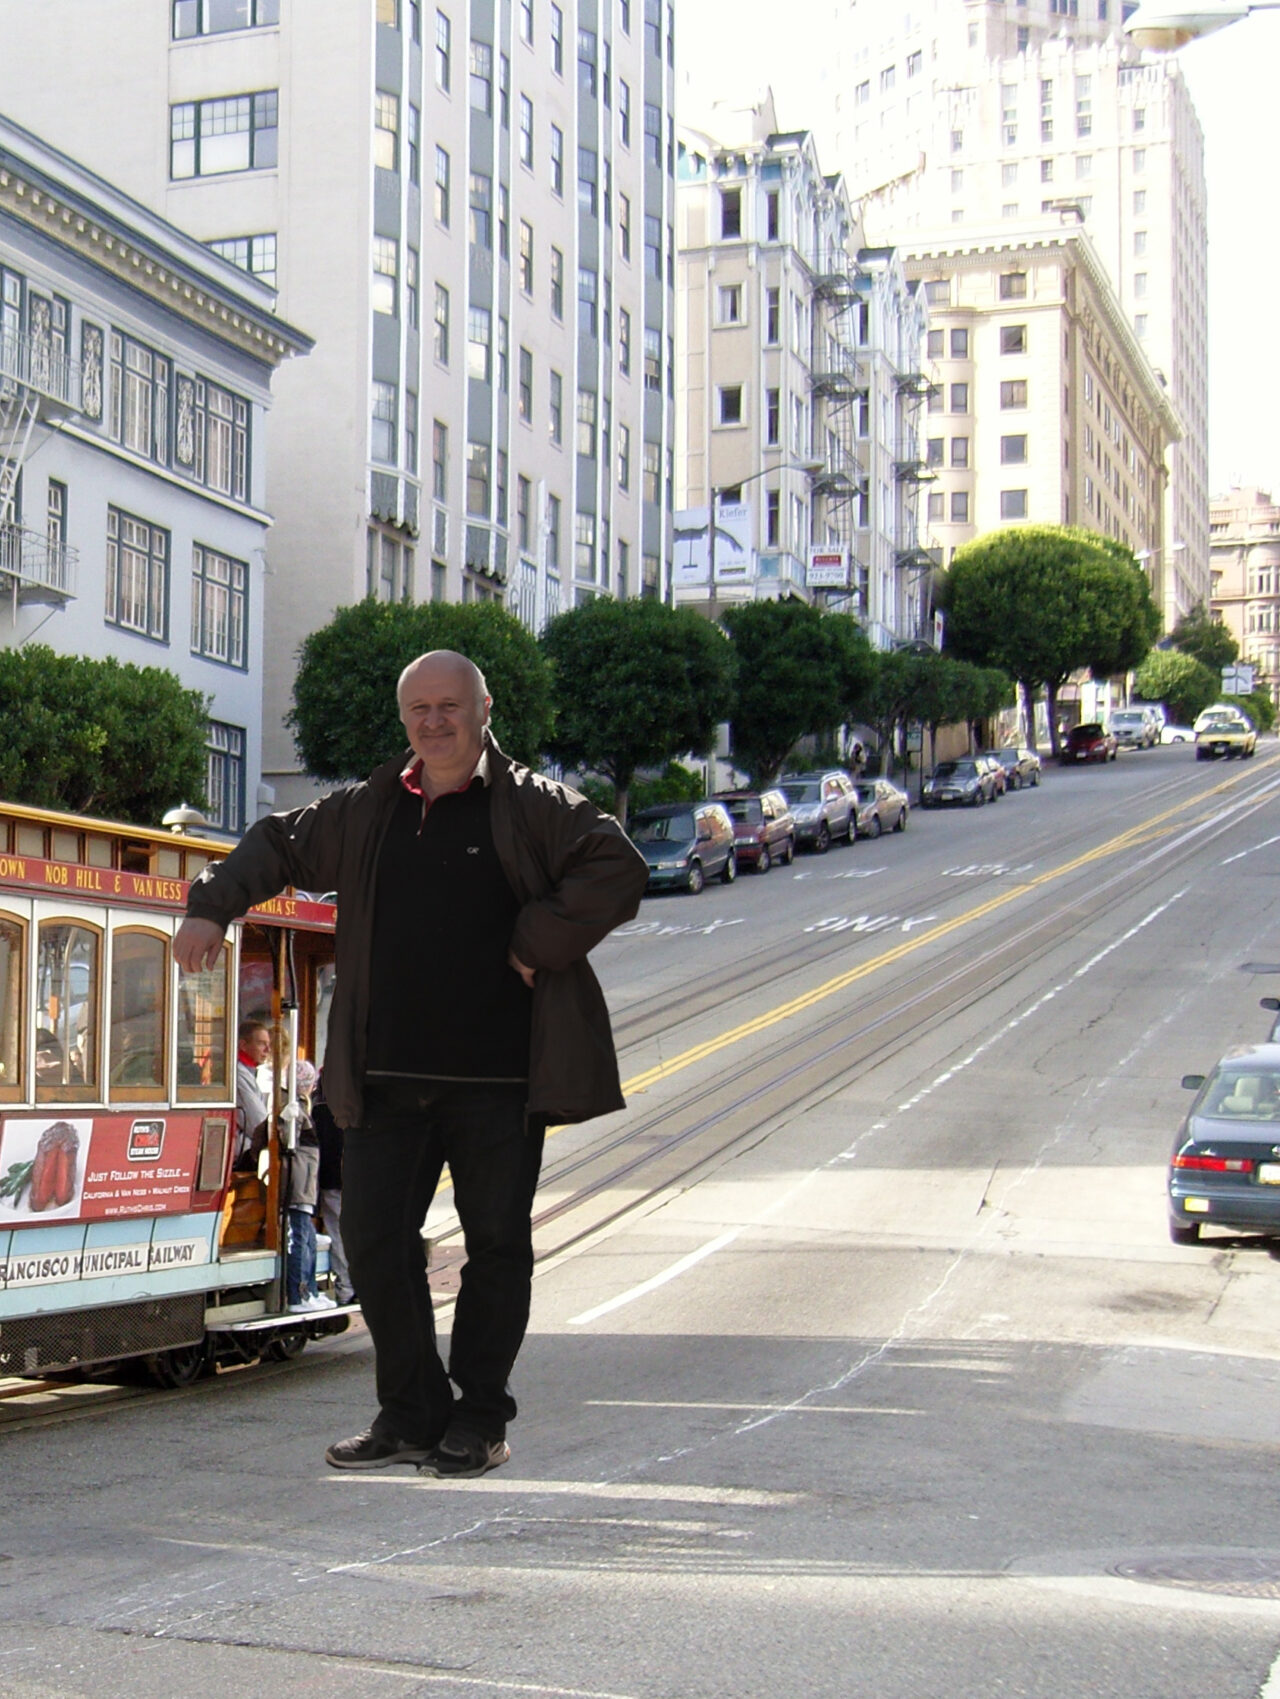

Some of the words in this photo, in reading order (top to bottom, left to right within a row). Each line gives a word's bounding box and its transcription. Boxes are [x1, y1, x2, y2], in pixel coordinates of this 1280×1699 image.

[45, 864, 69, 886] NOB
[76, 869, 102, 890] HILL
[114, 874, 122, 893] &
[133, 877, 153, 897] VAN
[156, 881, 182, 900] NESS
[87, 1170, 108, 1183] JUST
[109, 1169, 139, 1181] FOLLOW
[140, 1168, 155, 1179] THE
[156, 1167, 181, 1178] SIZZLE
[83, 1190, 113, 1200] CALIFORNIA
[121, 1188, 131, 1197] VAN
[73, 1250, 142, 1274] MUNICIPAL
